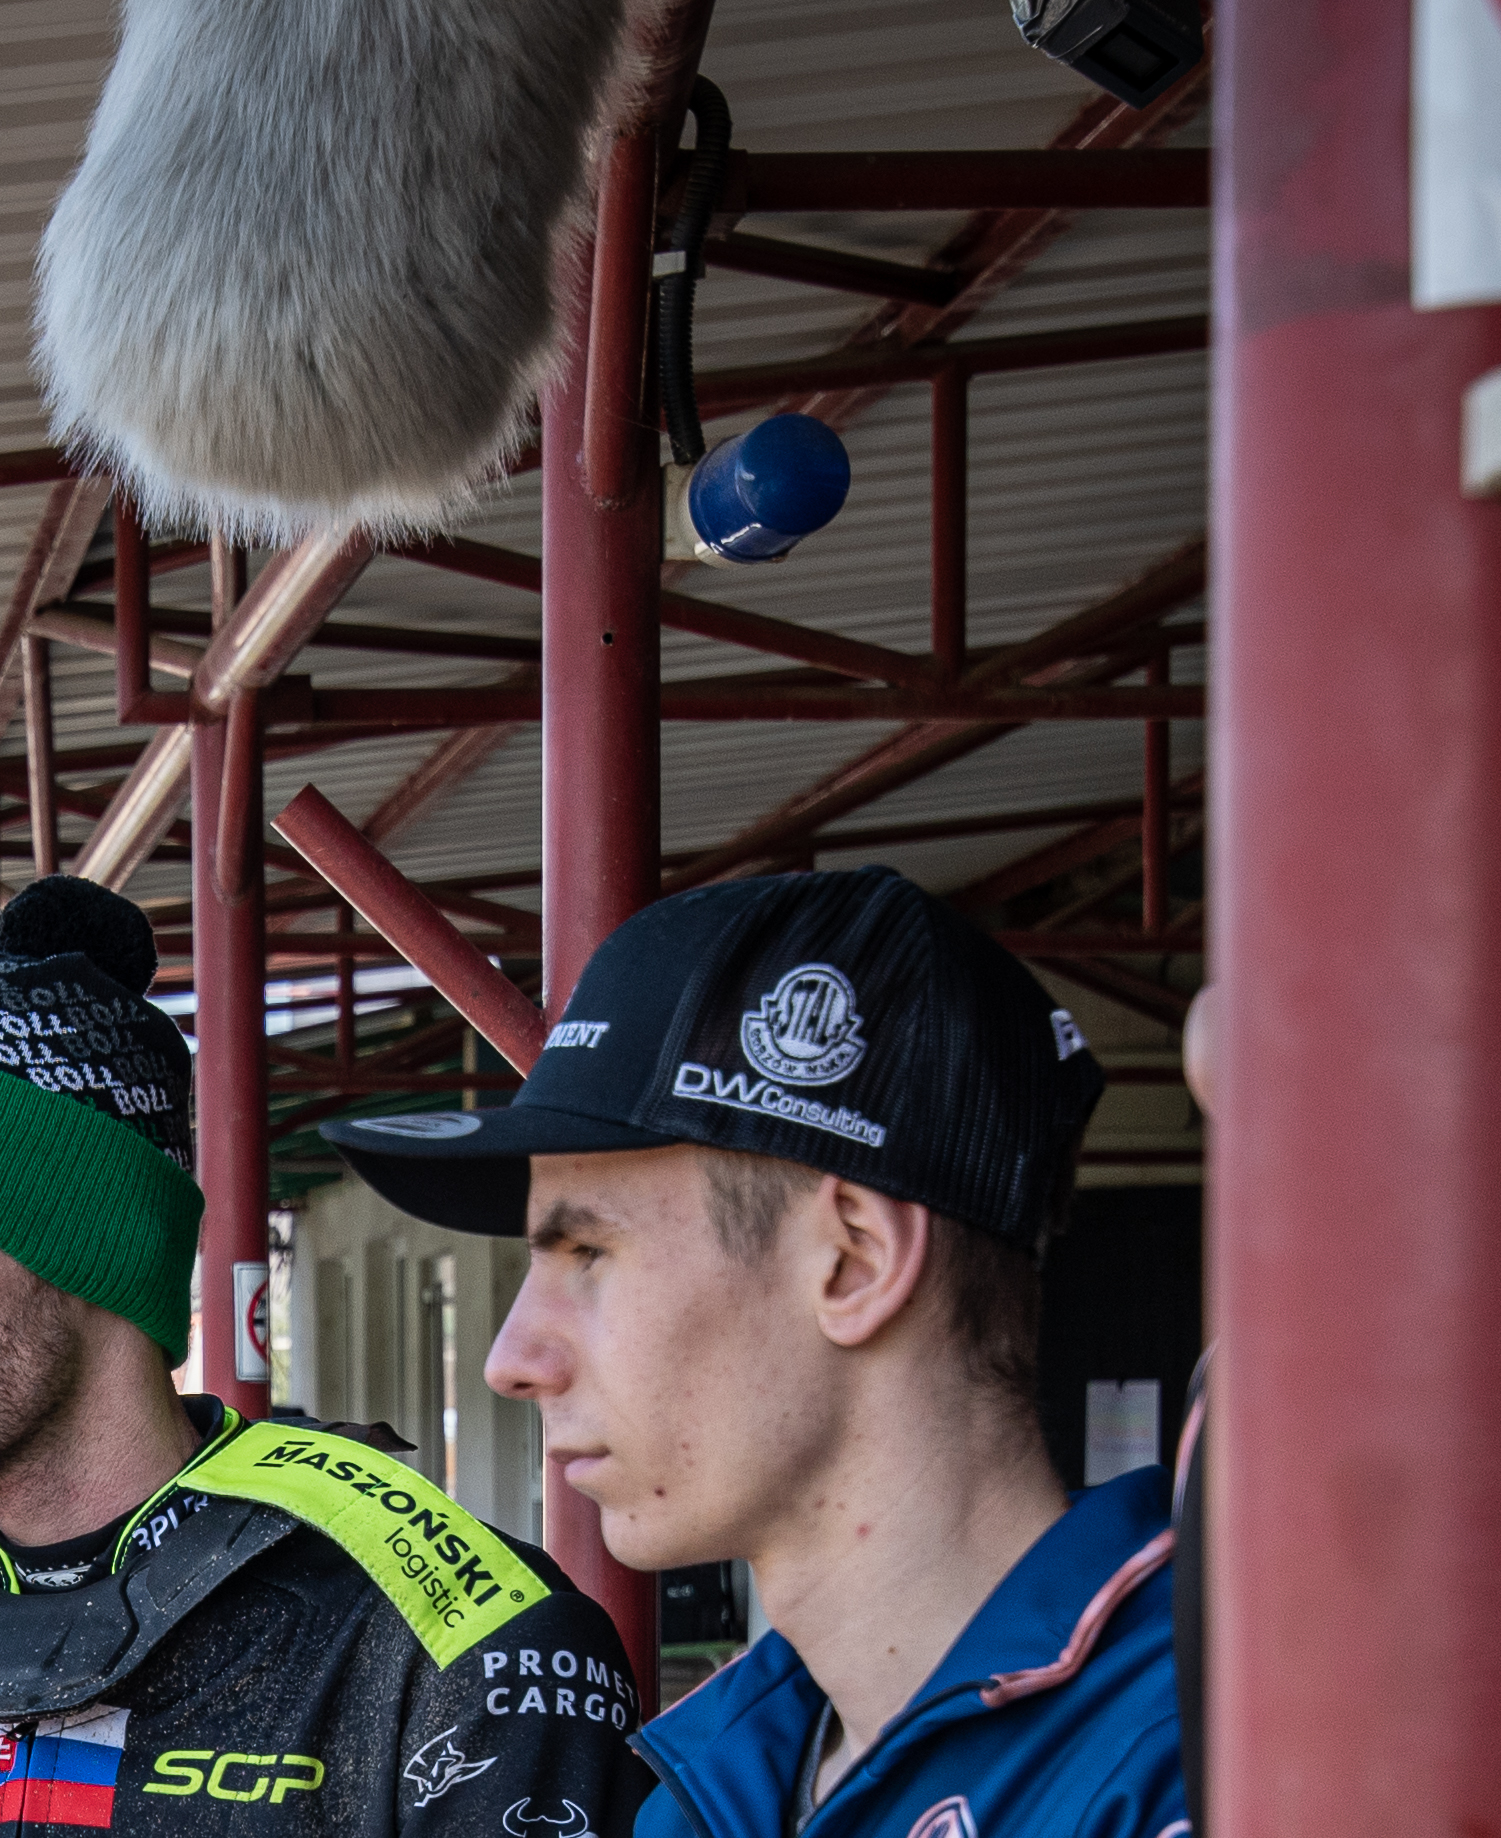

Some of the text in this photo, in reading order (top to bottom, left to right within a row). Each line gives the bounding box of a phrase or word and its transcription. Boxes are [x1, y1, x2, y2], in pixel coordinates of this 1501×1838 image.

[253, 1440, 503, 1608] MASZOŃSKI
[383, 1526, 466, 1630] logistic
[486, 1685, 627, 1731] CARGO
[142, 1749, 325, 1805] SGP
